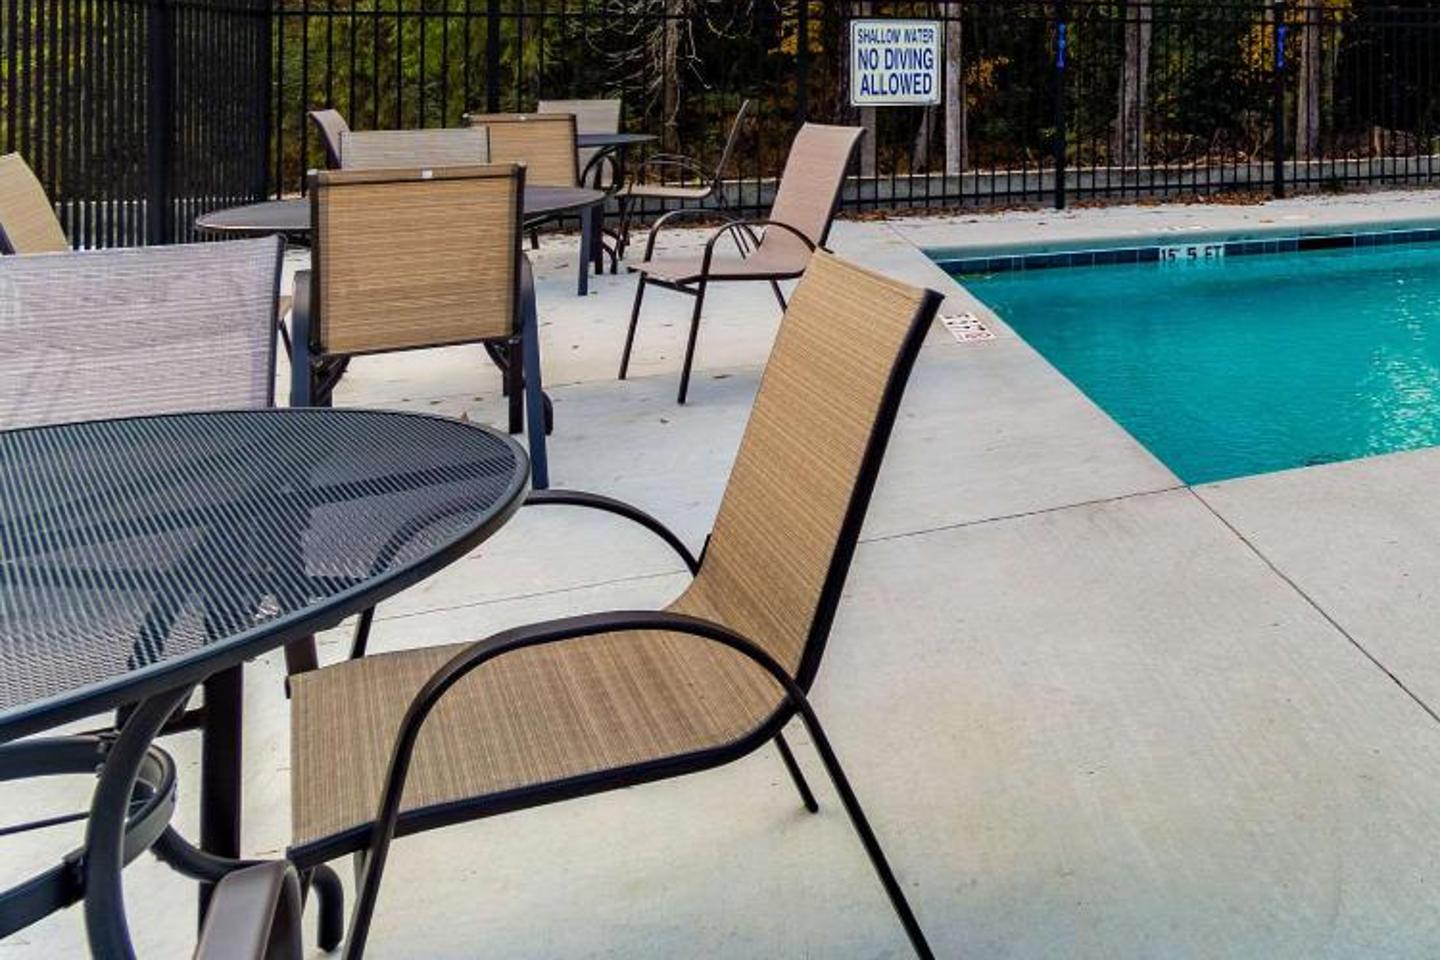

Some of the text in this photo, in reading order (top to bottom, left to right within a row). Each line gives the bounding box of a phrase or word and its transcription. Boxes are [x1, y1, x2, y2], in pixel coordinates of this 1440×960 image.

[858, 28, 934, 43] SHALLOW WATER
[858, 48, 933, 70] NO DIVING
[860, 73, 932, 95] ALLOWED
